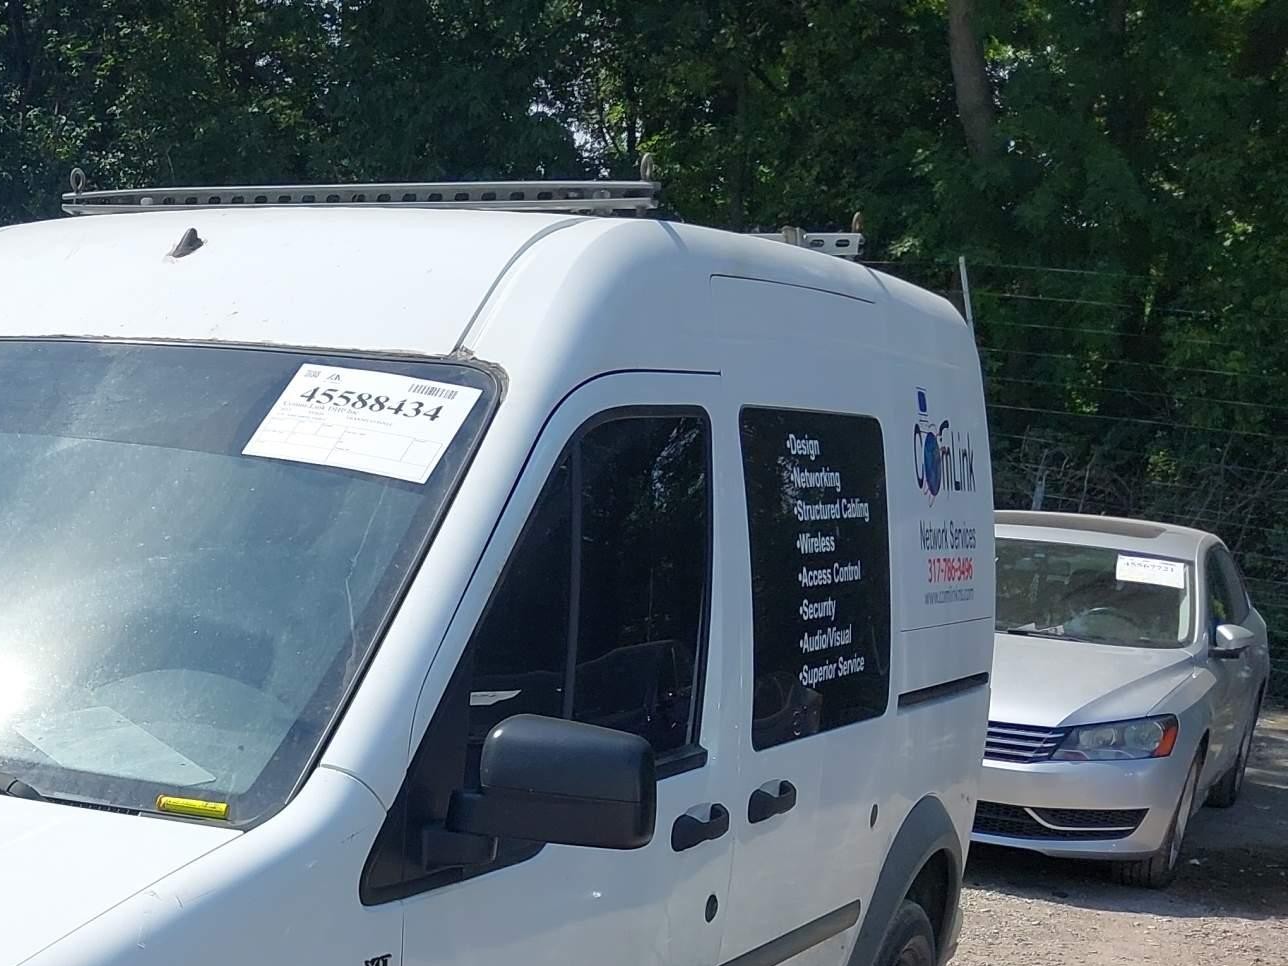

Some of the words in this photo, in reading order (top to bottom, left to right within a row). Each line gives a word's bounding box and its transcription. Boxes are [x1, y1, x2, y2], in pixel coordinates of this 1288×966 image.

[300, 386, 444, 421] 45588434
[789, 433, 820, 460] Design
[793, 466, 841, 492] Networking
[797, 499, 841, 521] Structured
[841, 498, 870, 522] Cabling
[798, 531, 835, 554] Wireless
[919, 519, 949, 551] Network
[949, 520, 977, 551] Services
[802, 566, 831, 587] Access
[833, 560, 861, 583] Control
[802, 597, 836, 620] Security
[802, 624, 852, 653] Audio/Visual
[802, 660, 838, 688] Superior
[838, 653, 865, 677] Service
